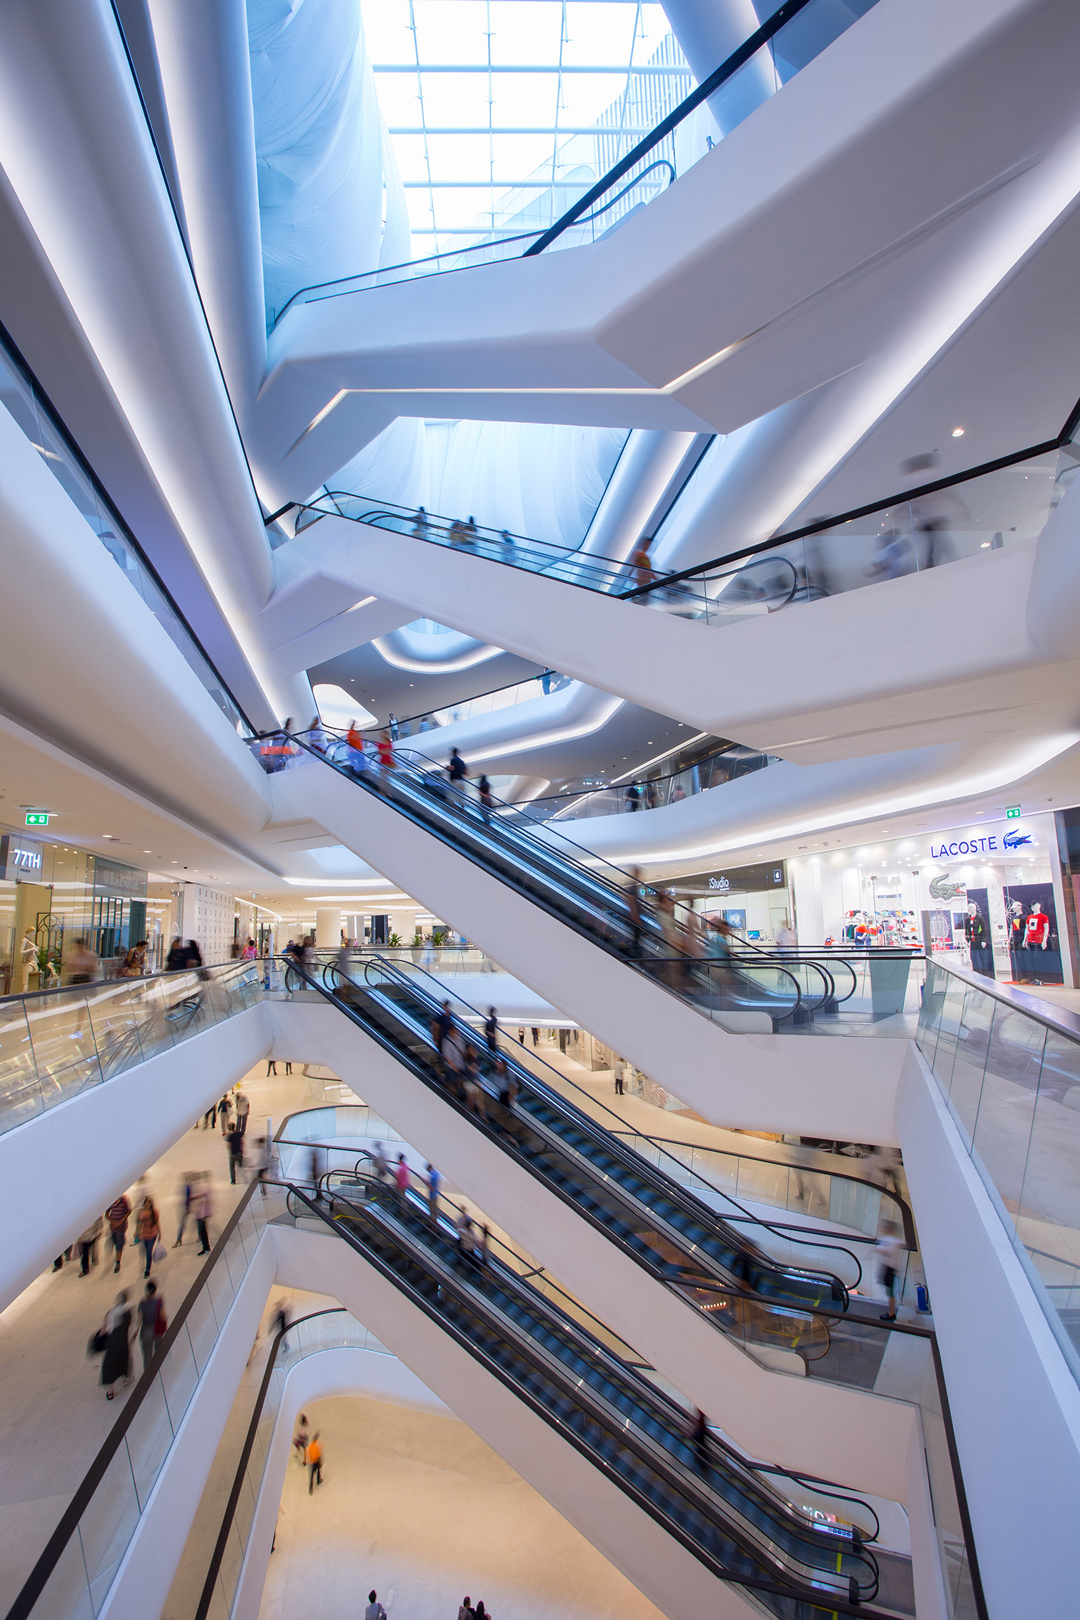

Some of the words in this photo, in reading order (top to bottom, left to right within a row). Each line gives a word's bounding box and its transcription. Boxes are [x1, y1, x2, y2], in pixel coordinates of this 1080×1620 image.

[930, 836, 998, 858] LACOSTE
[13, 848, 41, 869] 77TH
[708, 875, 730, 889] iStudio
